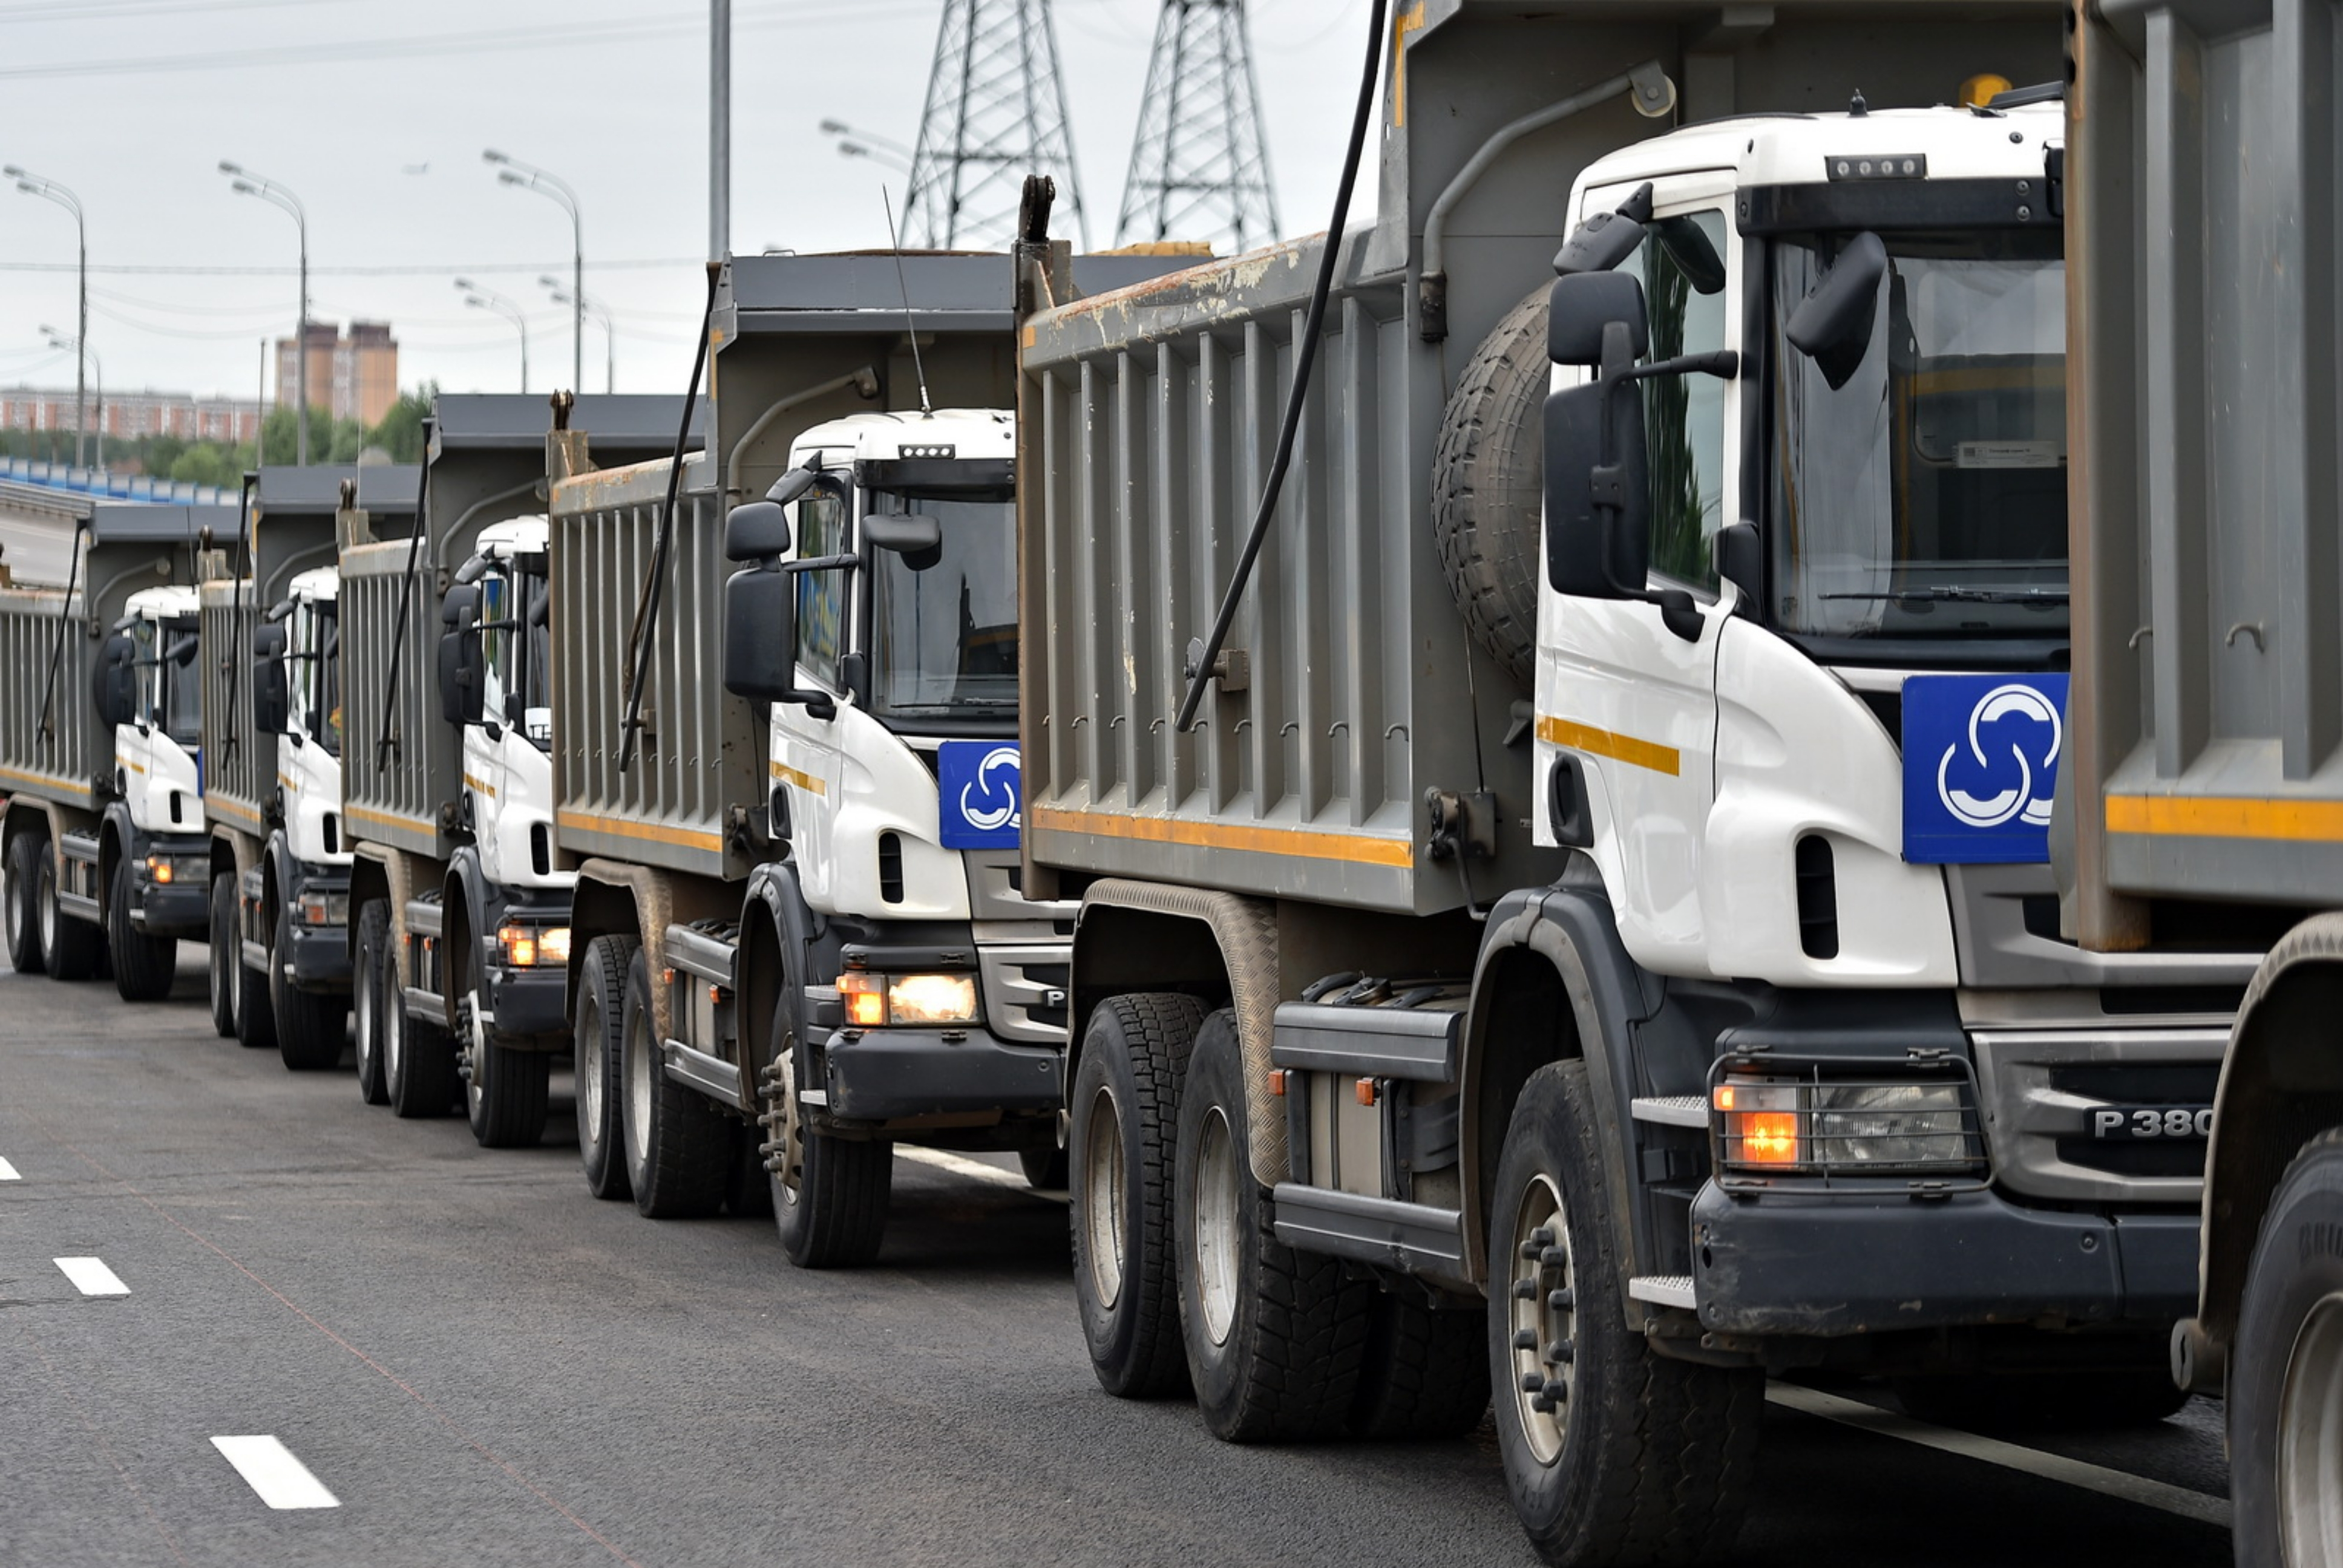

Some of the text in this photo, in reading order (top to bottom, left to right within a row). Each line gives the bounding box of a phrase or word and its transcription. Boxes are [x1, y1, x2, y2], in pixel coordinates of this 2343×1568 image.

[1047, 990, 1065, 1007] P
[2095, 1109, 2214, 1138] P 380
